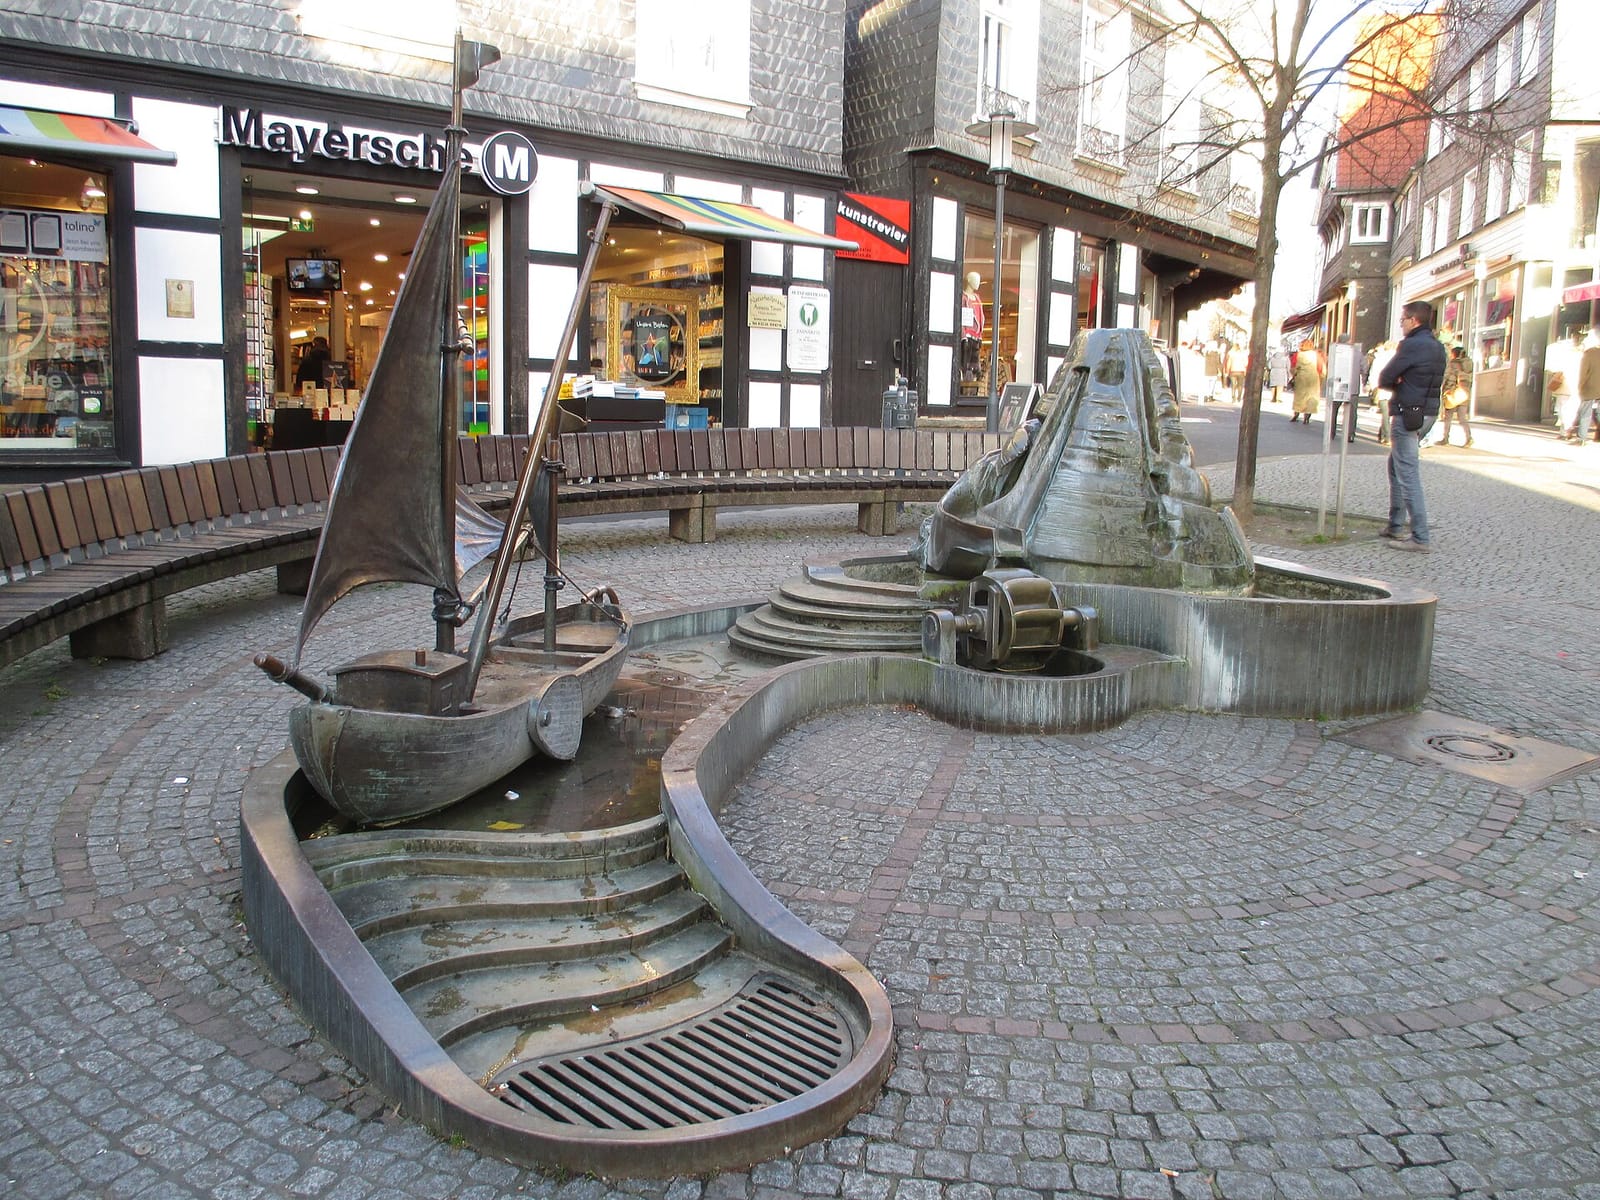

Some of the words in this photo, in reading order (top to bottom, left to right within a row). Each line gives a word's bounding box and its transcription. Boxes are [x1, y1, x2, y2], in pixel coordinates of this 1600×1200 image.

[218, 104, 474, 173] Mayersche
[494, 143, 530, 182] M
[65, 221, 95, 232] tolino
[837, 200, 907, 243] kunstrevier
